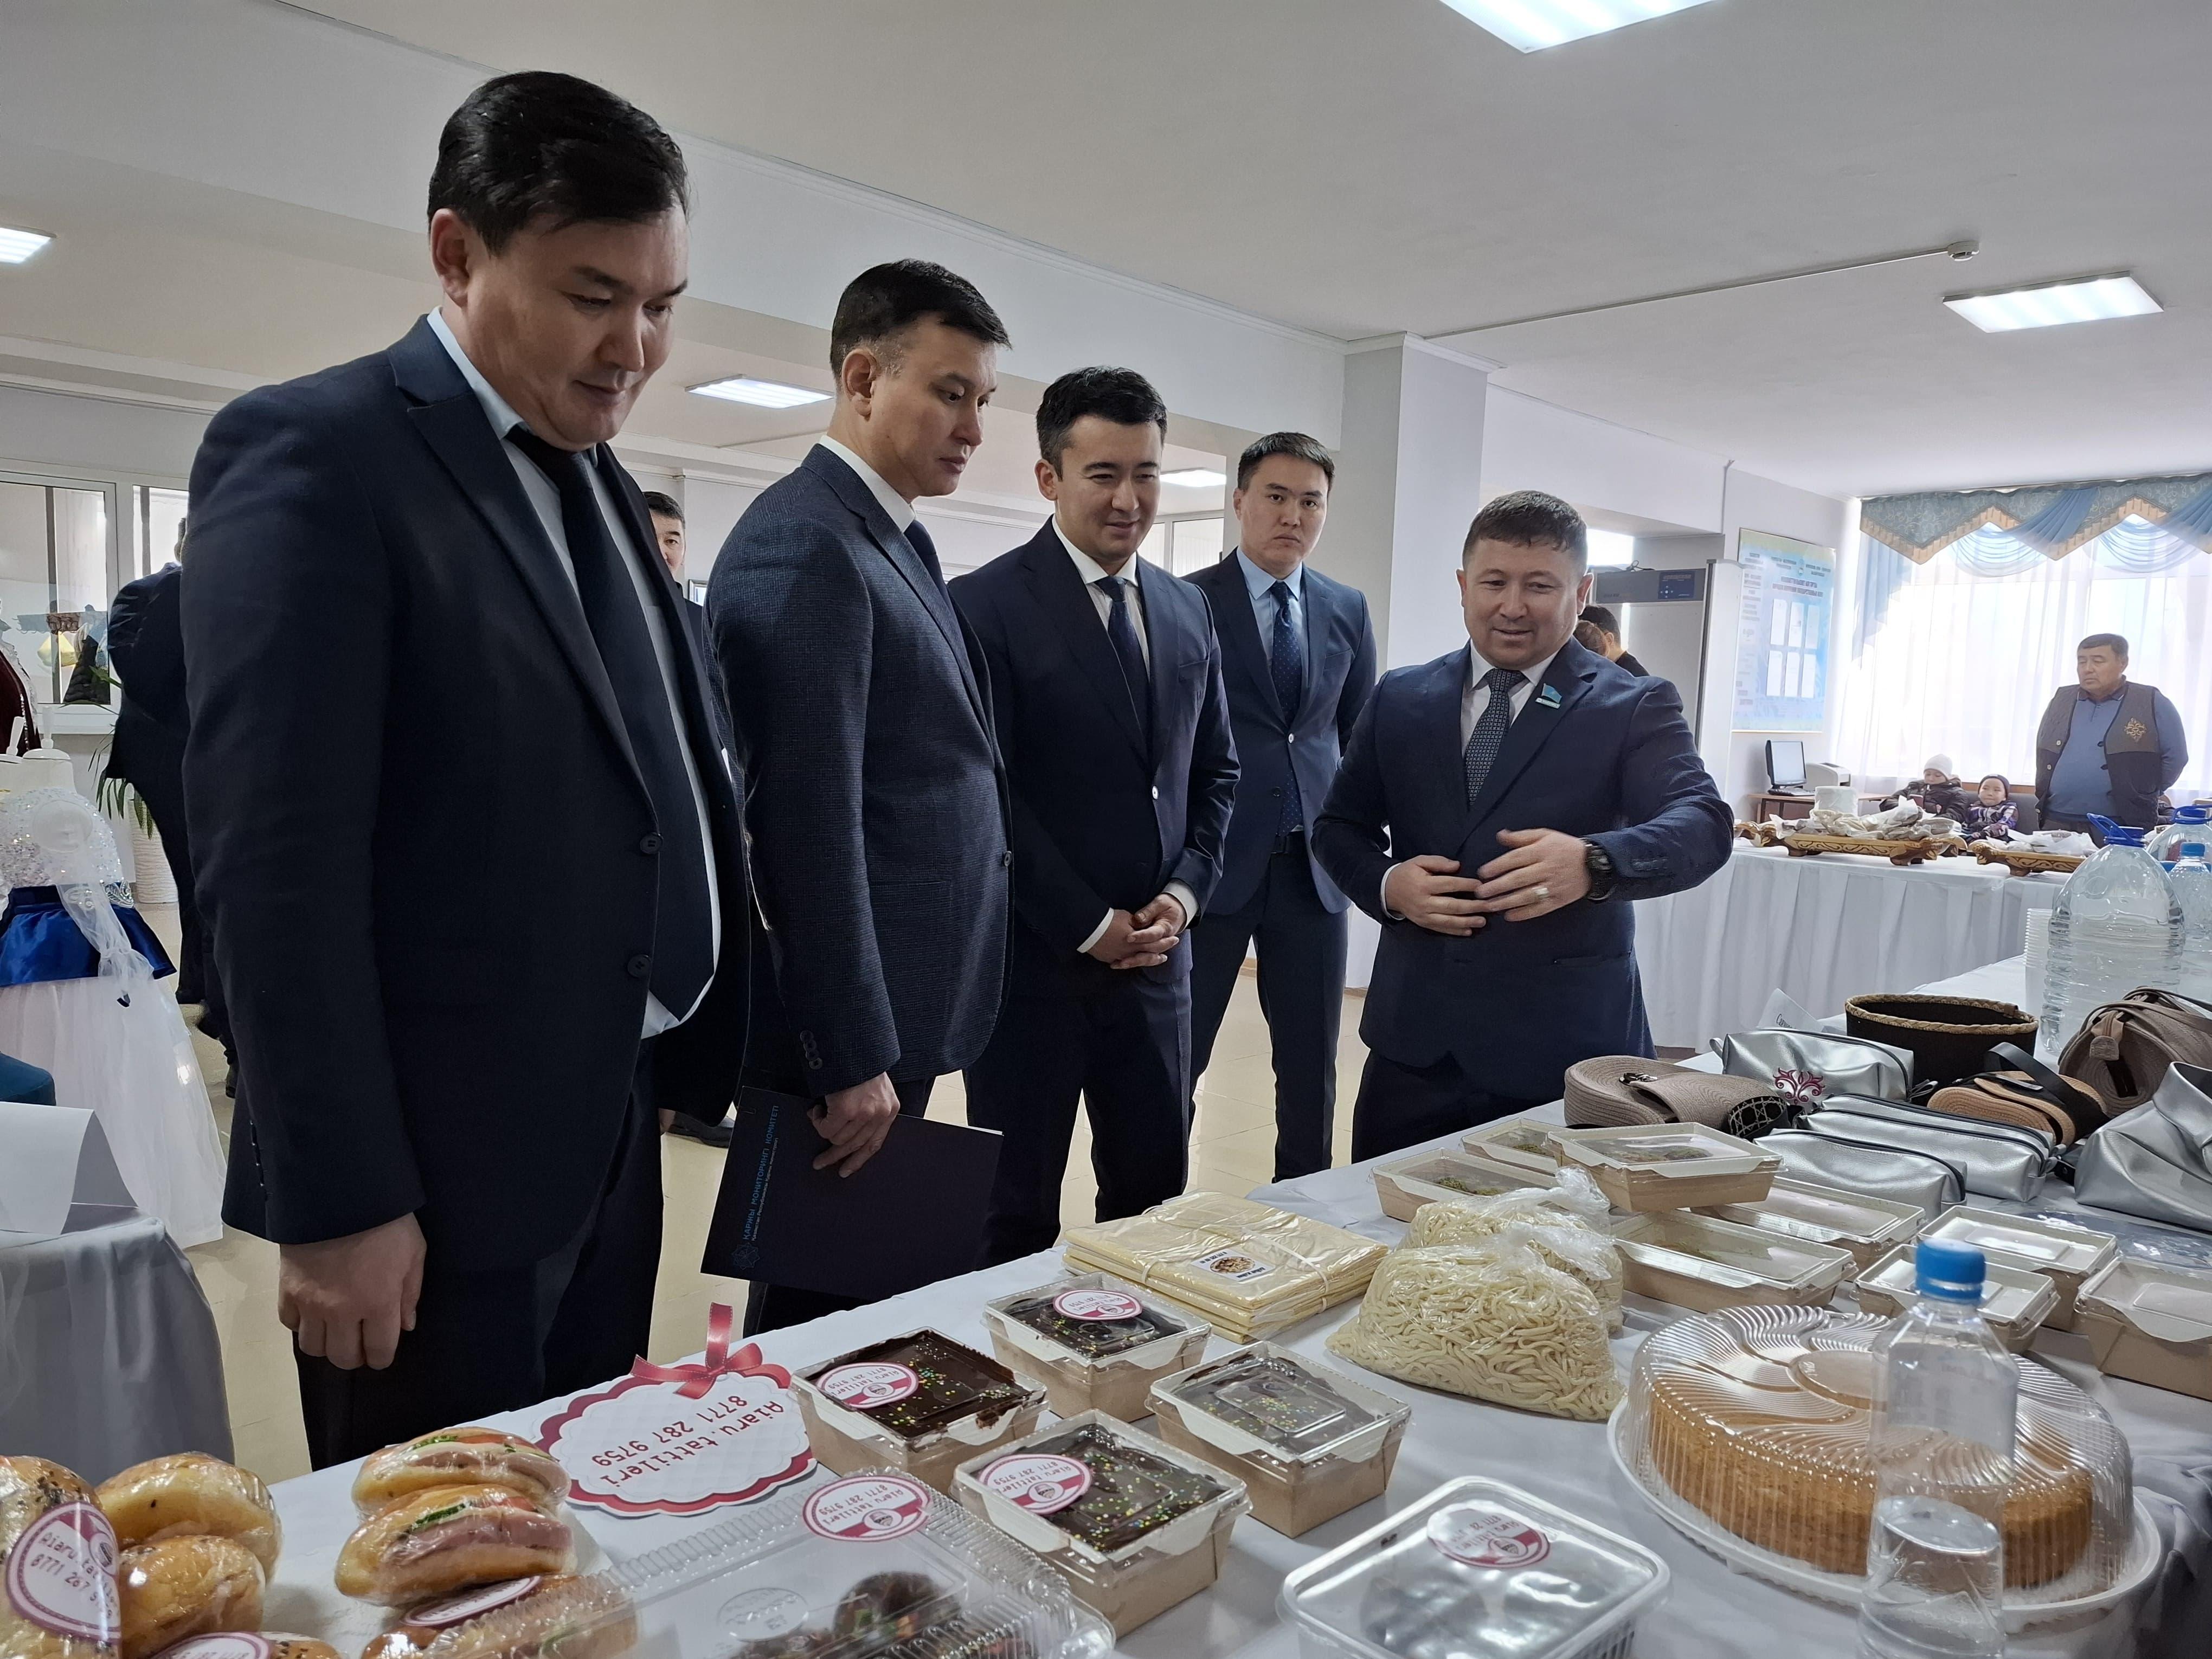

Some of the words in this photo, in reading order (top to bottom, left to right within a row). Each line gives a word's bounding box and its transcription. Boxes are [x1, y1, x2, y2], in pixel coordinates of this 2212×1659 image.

[743, 1209, 756, 1241] ҚАРЖЫ
[751, 1148, 769, 1205] МОНИТОРИНГІ
[828, 1379, 847, 1388] 9759
[849, 1374, 865, 1382] 287
[696, 1396, 747, 1423] 8771
[652, 1420, 694, 1444] 287
[591, 1441, 648, 1467] 9759
[1038, 1461, 1058, 1470] 8771
[1019, 1468, 1033, 1477] 287
[993, 1474, 1016, 1485] 9759
[864, 1484, 888, 1497] 8771
[845, 1495, 863, 1505] 287
[819, 1503, 843, 1515] 9759
[31, 1554, 65, 1576] 8771
